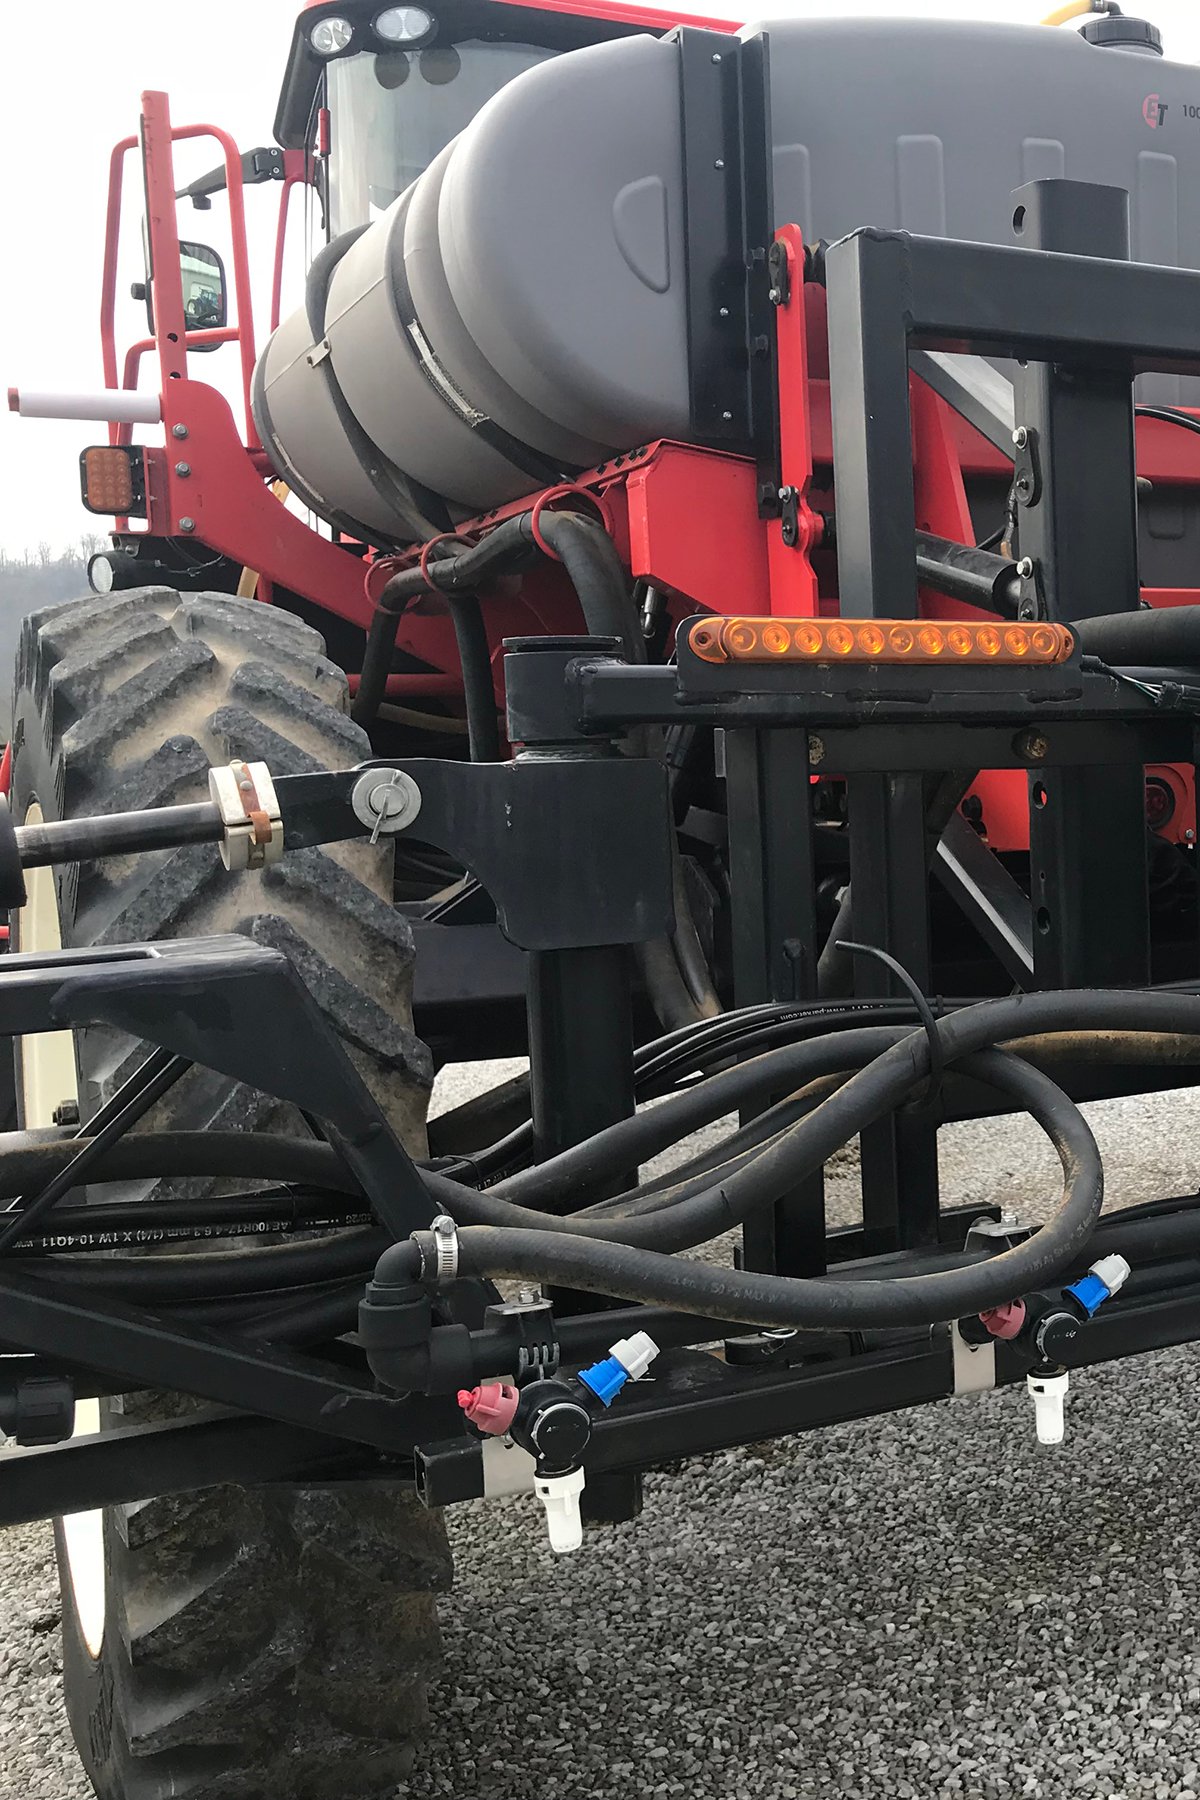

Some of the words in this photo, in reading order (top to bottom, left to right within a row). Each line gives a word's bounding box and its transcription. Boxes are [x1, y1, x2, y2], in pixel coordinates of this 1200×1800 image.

[98, 1232, 119, 1245] 1W
[123, 1231, 134, 1242] X
[136, 1229, 164, 1242] (1/4)
[167, 1227, 191, 1238] mm
[42, 1234, 95, 1248] 10-4Q11
